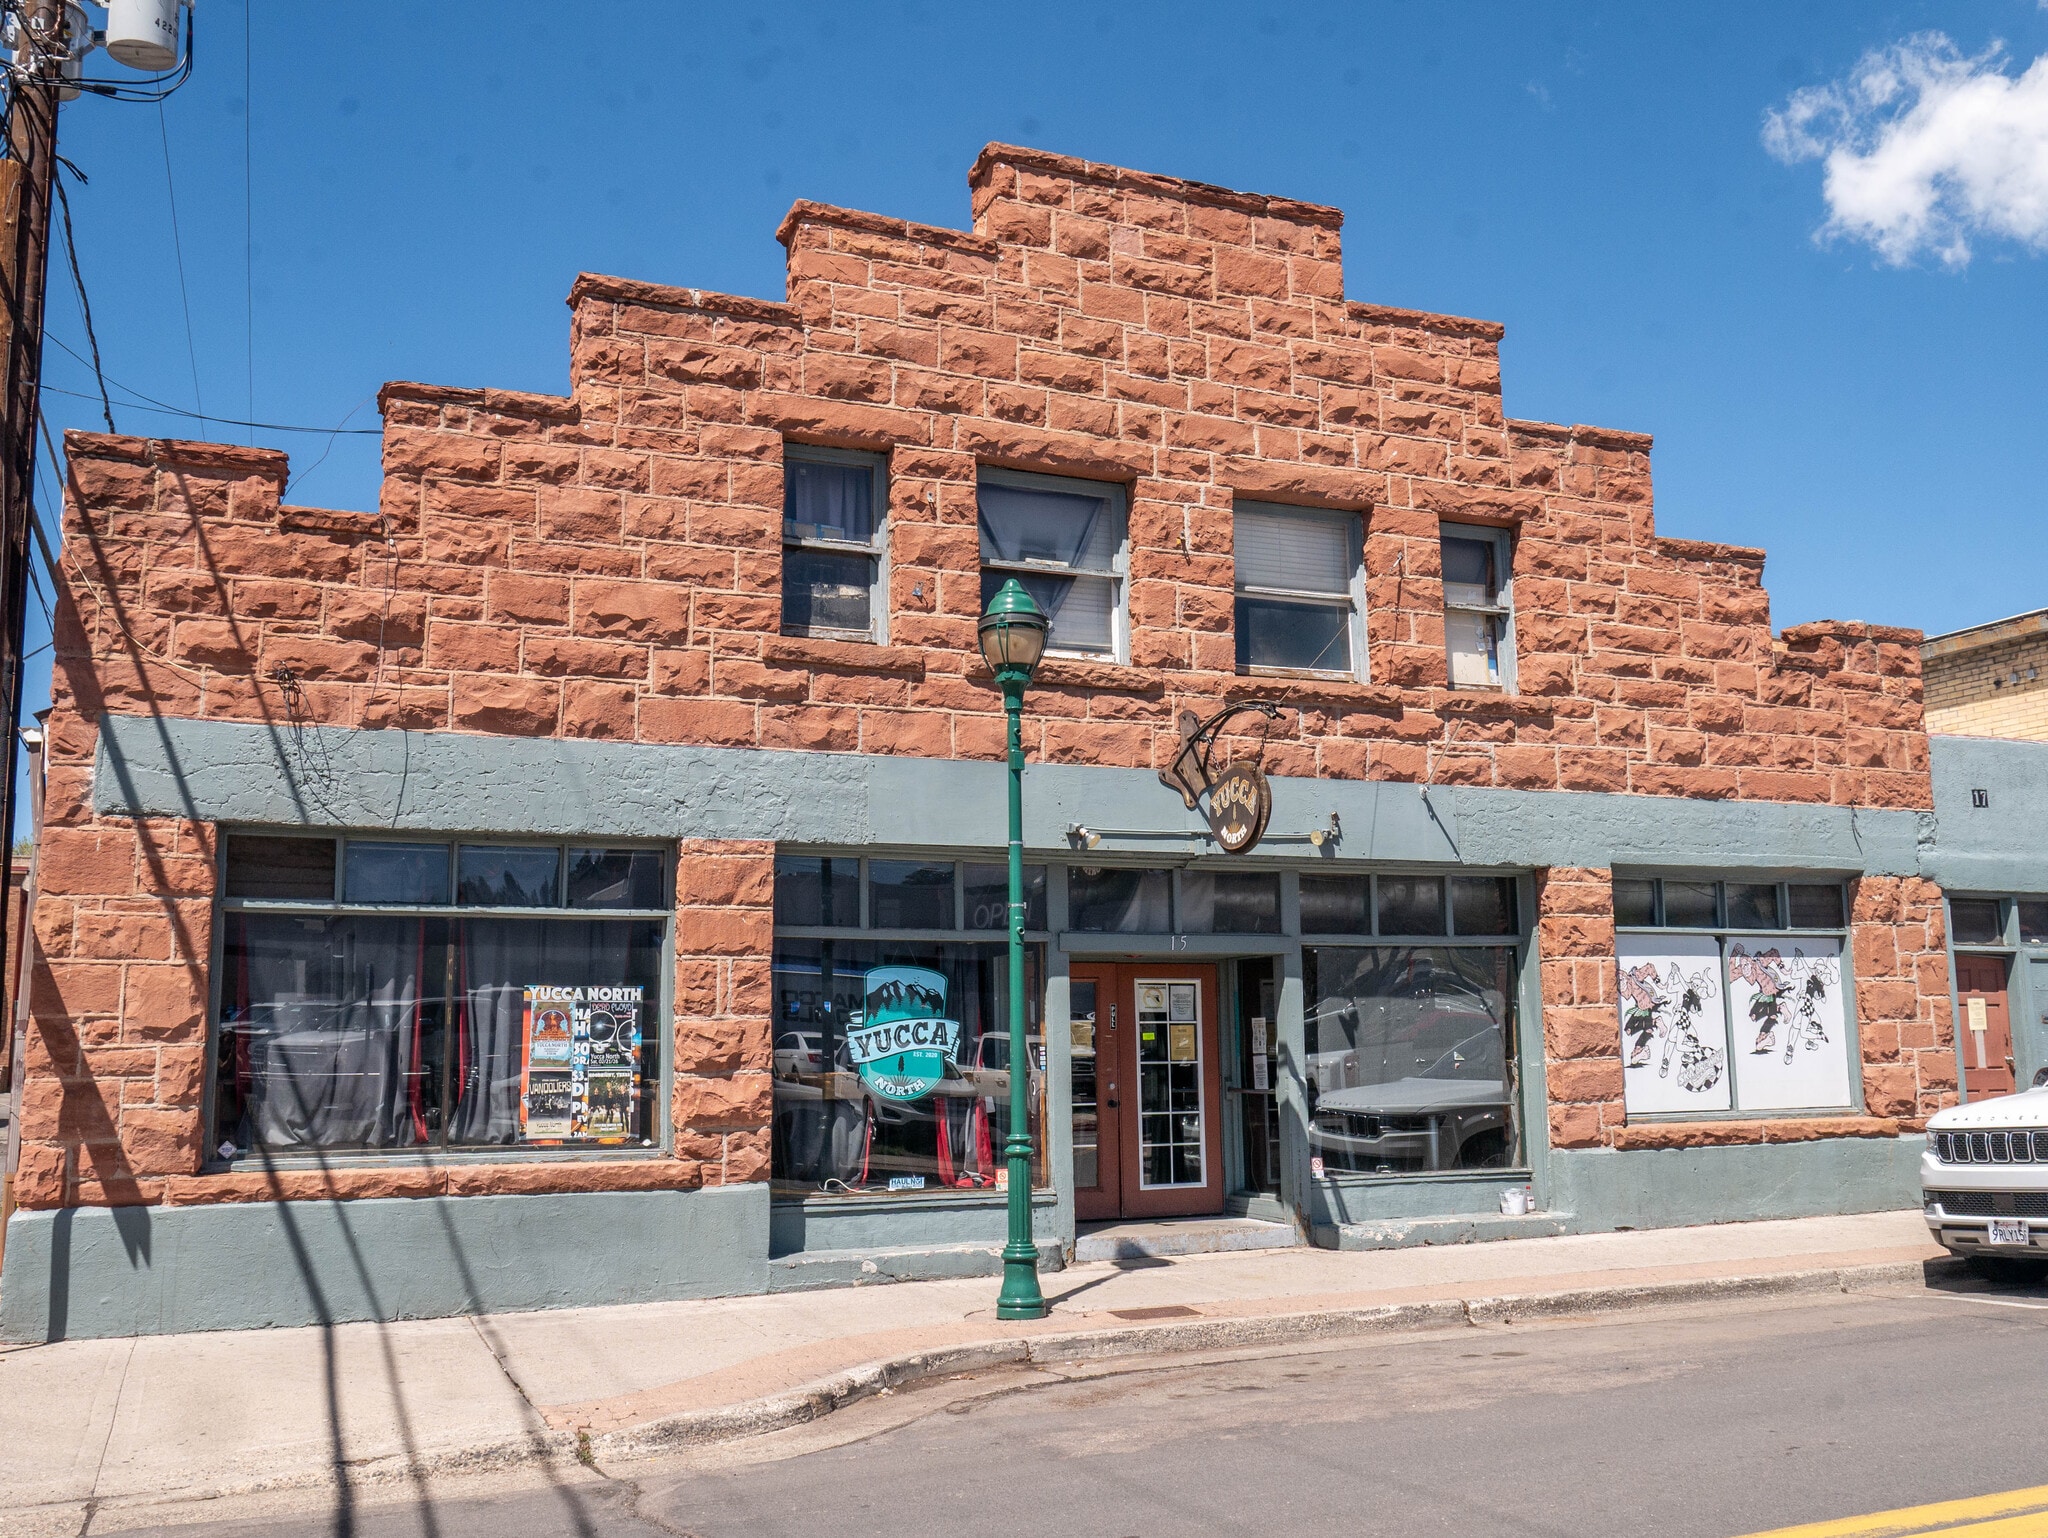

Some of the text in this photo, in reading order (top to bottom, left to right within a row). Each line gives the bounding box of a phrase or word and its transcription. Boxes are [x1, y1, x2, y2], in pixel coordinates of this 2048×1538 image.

[1211, 776, 1257, 817] YUCCA
[1973, 790, 1986, 806] 17
[1221, 824, 1247, 843] NORTH
[1171, 935, 1187, 950] 15
[529, 987, 642, 1000] YUCCA NORTH
[854, 1022, 949, 1058] YUCCA
[874, 1076, 926, 1096] NORTH
